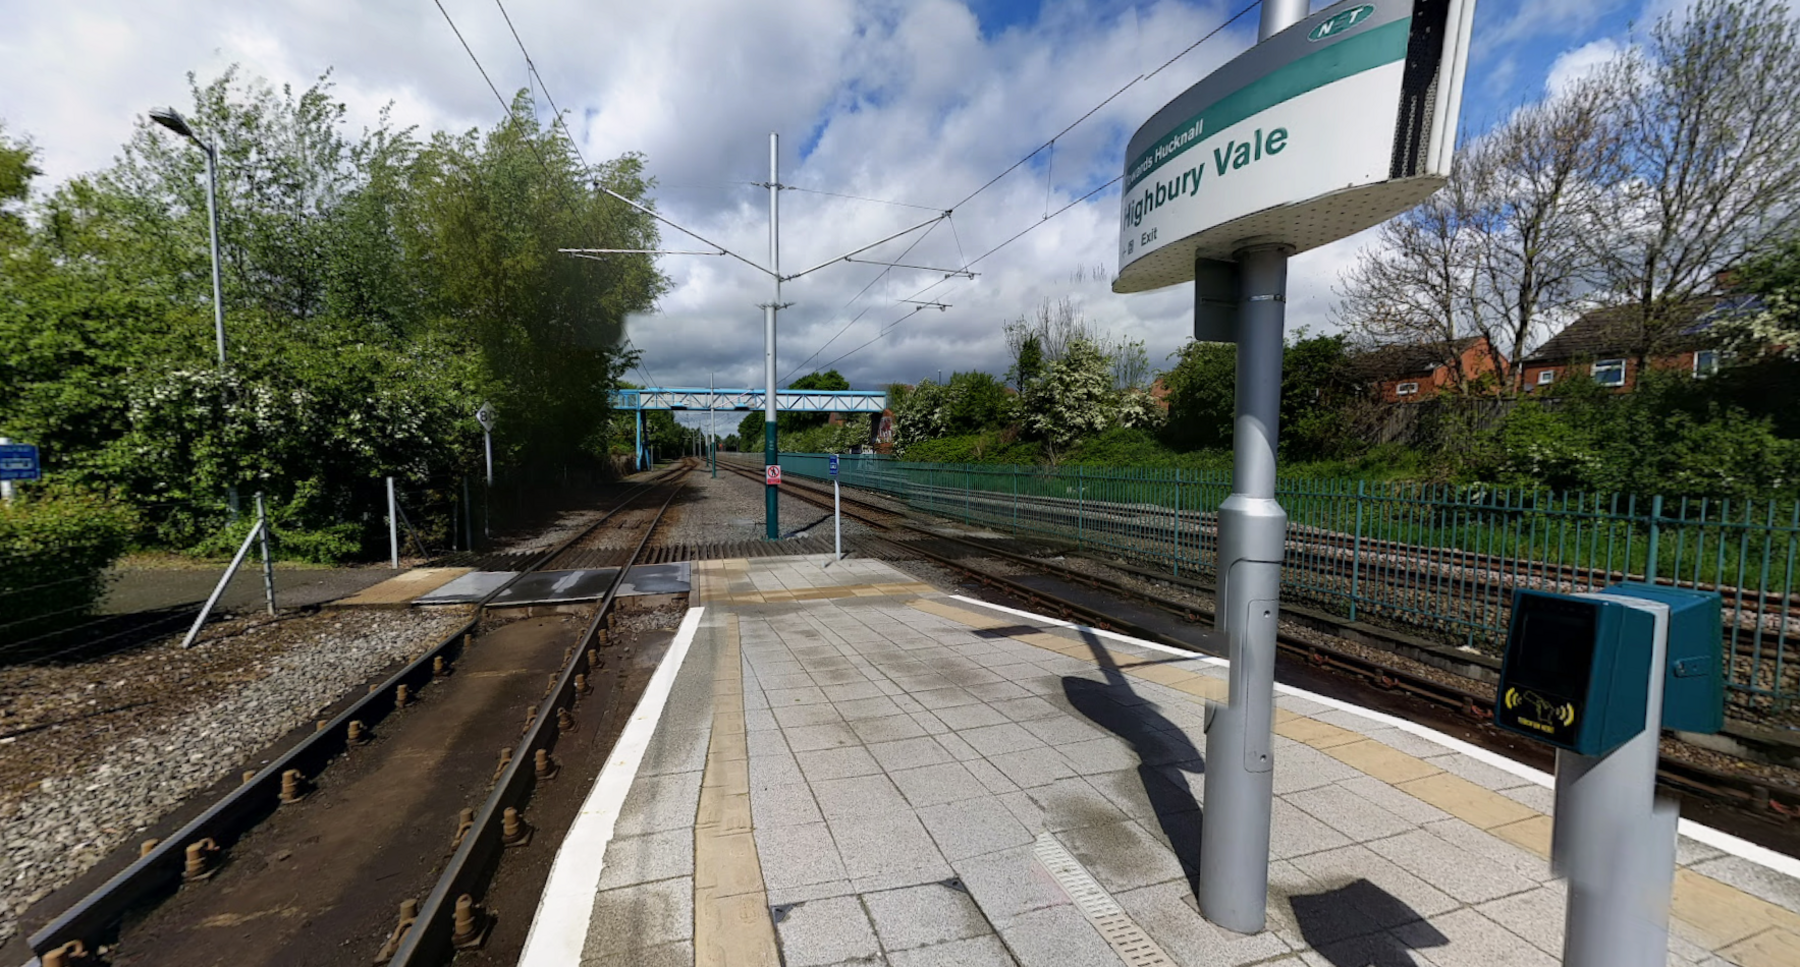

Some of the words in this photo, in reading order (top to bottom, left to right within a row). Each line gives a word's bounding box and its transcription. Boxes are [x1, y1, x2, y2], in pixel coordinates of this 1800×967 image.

[1155, 118, 1204, 163] Hucknall
[1123, 162, 1205, 232] Highbury
[1213, 126, 1288, 177] Vale
[1141, 227, 1158, 246] Exit
